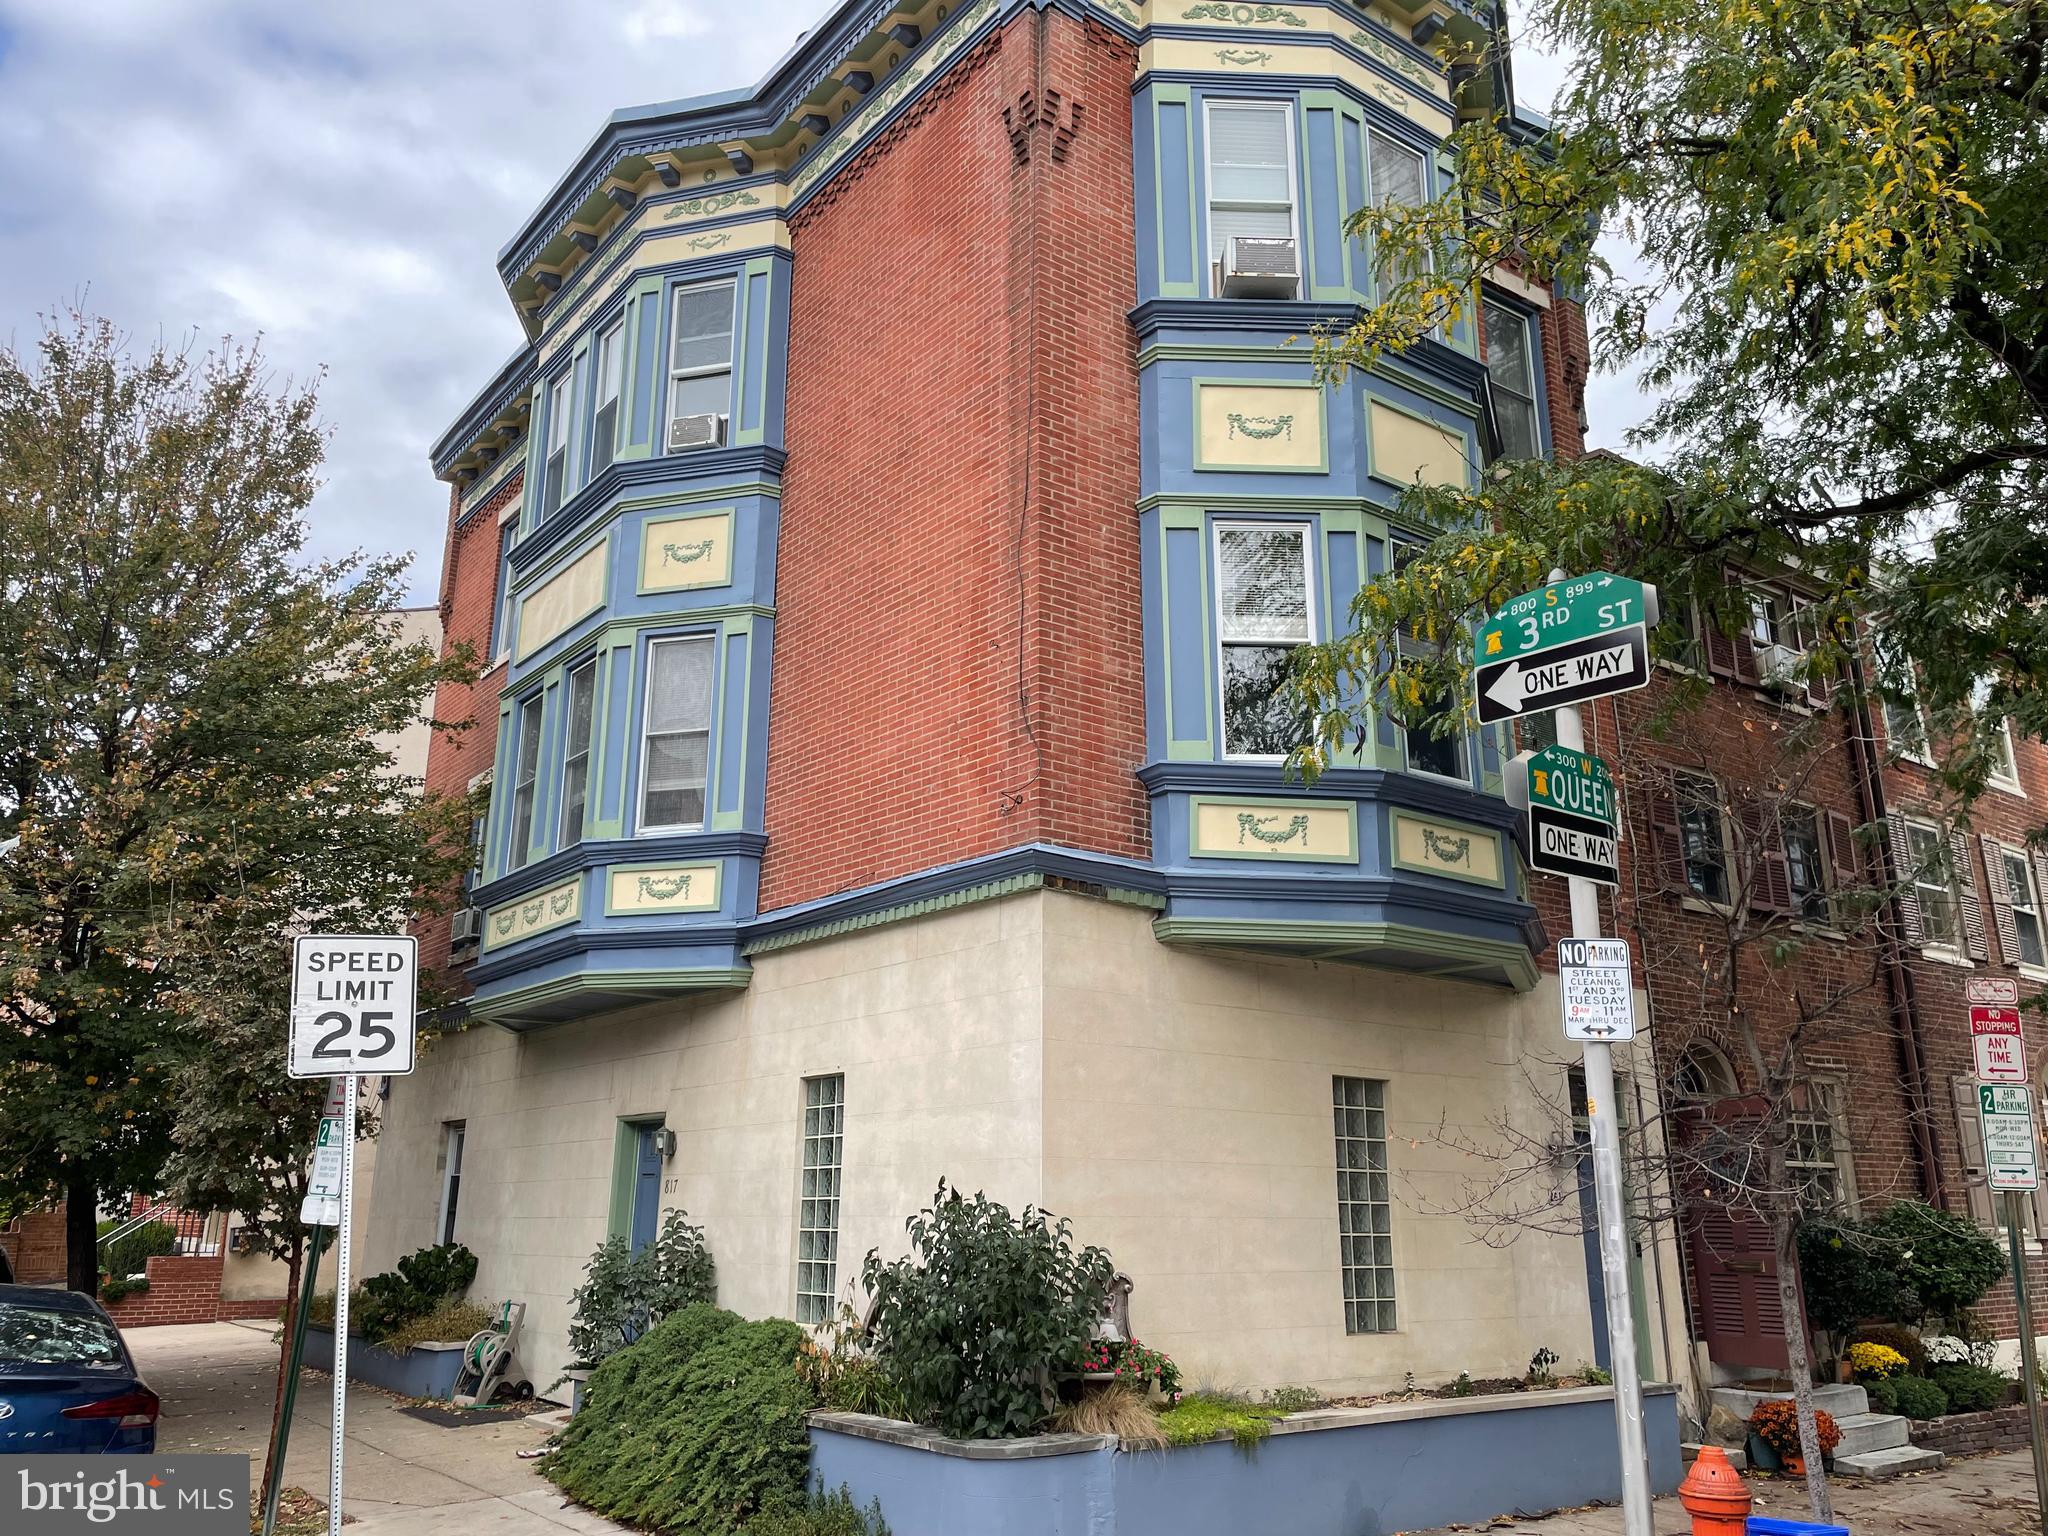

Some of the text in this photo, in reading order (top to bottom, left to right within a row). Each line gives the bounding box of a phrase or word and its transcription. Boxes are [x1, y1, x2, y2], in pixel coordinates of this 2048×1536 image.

[1510, 581, 1594, 616] 800 S 899
[1518, 599, 1632, 650] 3RD ST
[1524, 649, 1625, 694] ONE WAY
[1556, 752, 1576, 769] 300
[1580, 757, 1592, 777] W
[1551, 770, 1613, 821] QUEEN
[1546, 828, 1615, 865] ONE WAY
[307, 952, 404, 972] SPEED
[1561, 943, 1625, 965] NO PARKING
[1570, 977, 1621, 986] CLEANING
[1572, 969, 1618, 978] STREET
[317, 980, 394, 1001] LIMIT
[1568, 995, 1626, 1005] TUESDAY
[1583, 986, 1606, 995] AND
[1568, 1016, 1585, 1024] MAR
[1613, 1017, 1629, 1025] DEC
[1988, 1009, 2001, 1020] NO
[312, 1011, 396, 1059] 25
[1975, 1021, 2017, 1032] STOPPING
[1987, 1038, 2008, 1049] ANY
[1987, 1051, 2013, 1064] TIME
[1983, 1090, 2016, 1111] 2 HR
[1996, 1101, 2028, 1112] PARKING
[320, 1123, 329, 1143] 2
[664, 1179, 679, 1194] 817
